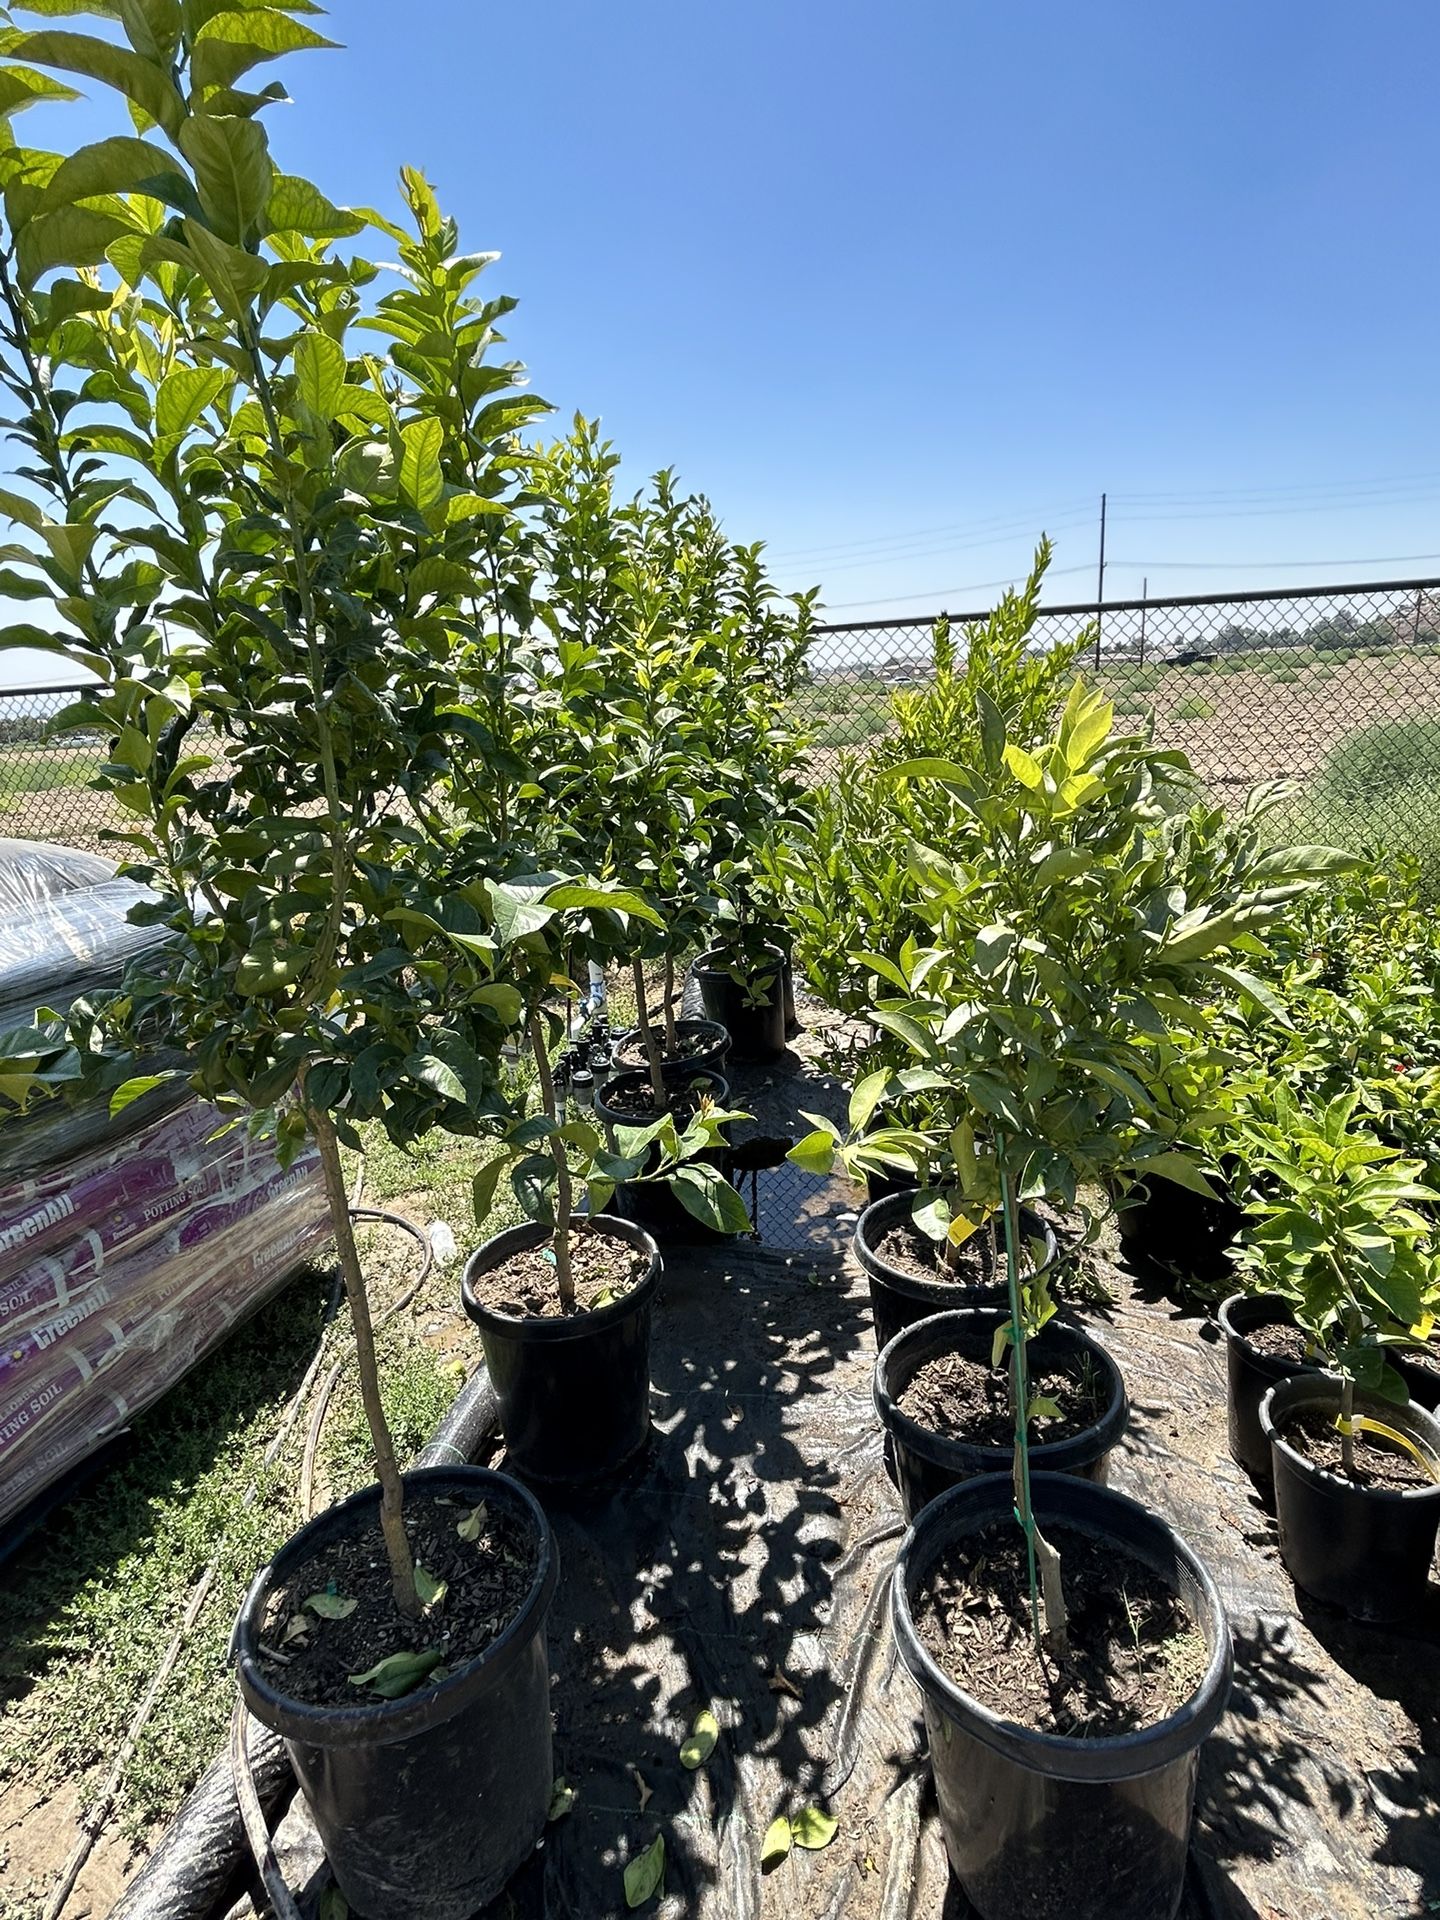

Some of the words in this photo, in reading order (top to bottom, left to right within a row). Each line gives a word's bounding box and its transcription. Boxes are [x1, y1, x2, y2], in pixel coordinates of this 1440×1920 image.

[143, 1192, 187, 1221] POTTING
[0, 1290, 33, 1317] SOIL
[31, 1284, 112, 1351] GreenAll
[30, 1383, 63, 1415] SOIL
